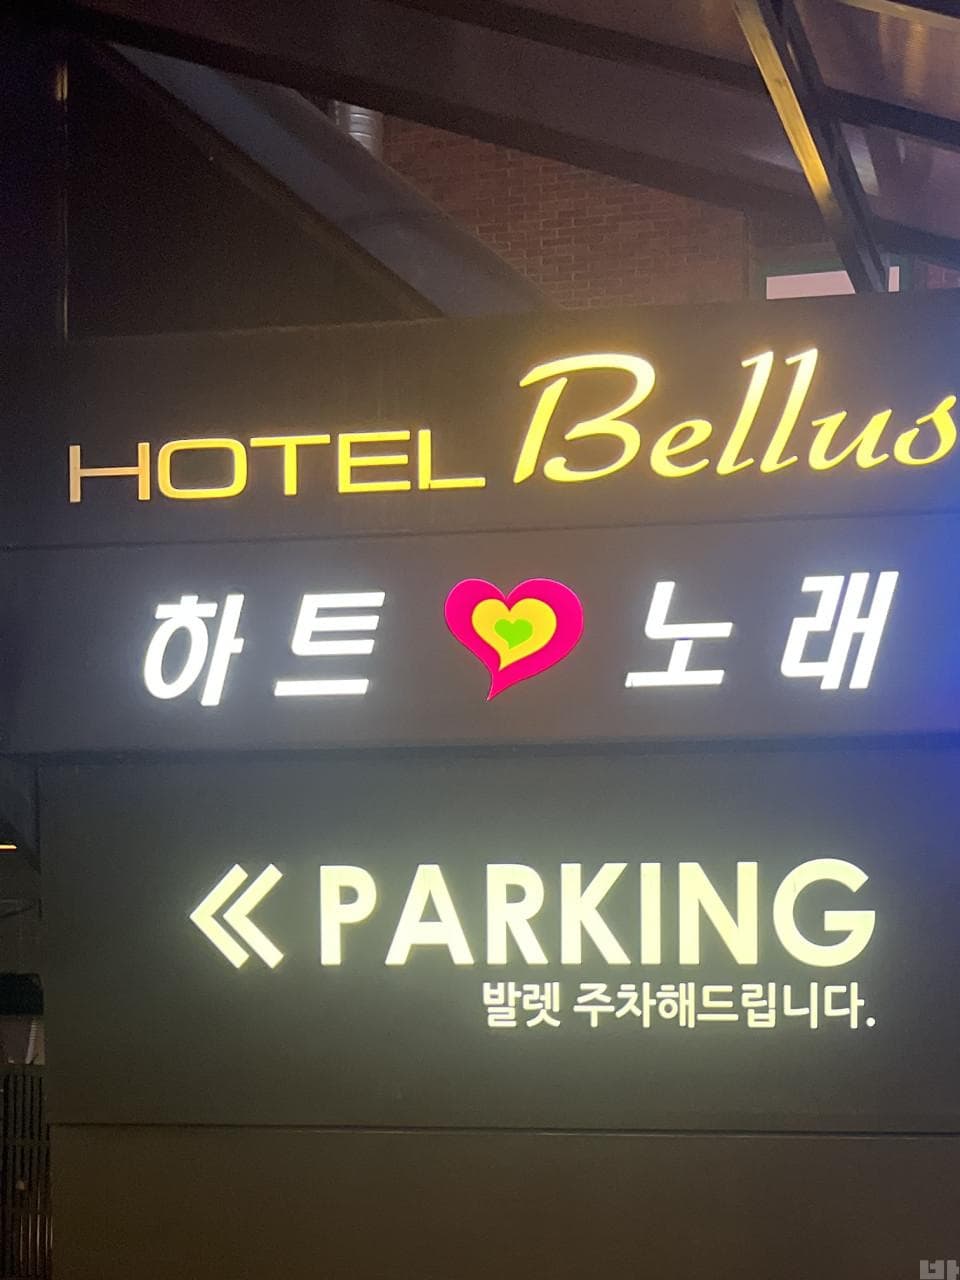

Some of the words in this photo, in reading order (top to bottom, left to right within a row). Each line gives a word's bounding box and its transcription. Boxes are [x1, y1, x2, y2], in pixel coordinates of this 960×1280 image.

[69, 430, 486, 502] HOTEL
[513, 348, 958, 485] Bellus
[143, 590, 386, 706] 하트
[625, 571, 900, 690] 노래
[320, 859, 876, 968] PARKING
[482, 982, 562, 1029] 발렛
[573, 981, 877, 1030] 주차해드립니다.
